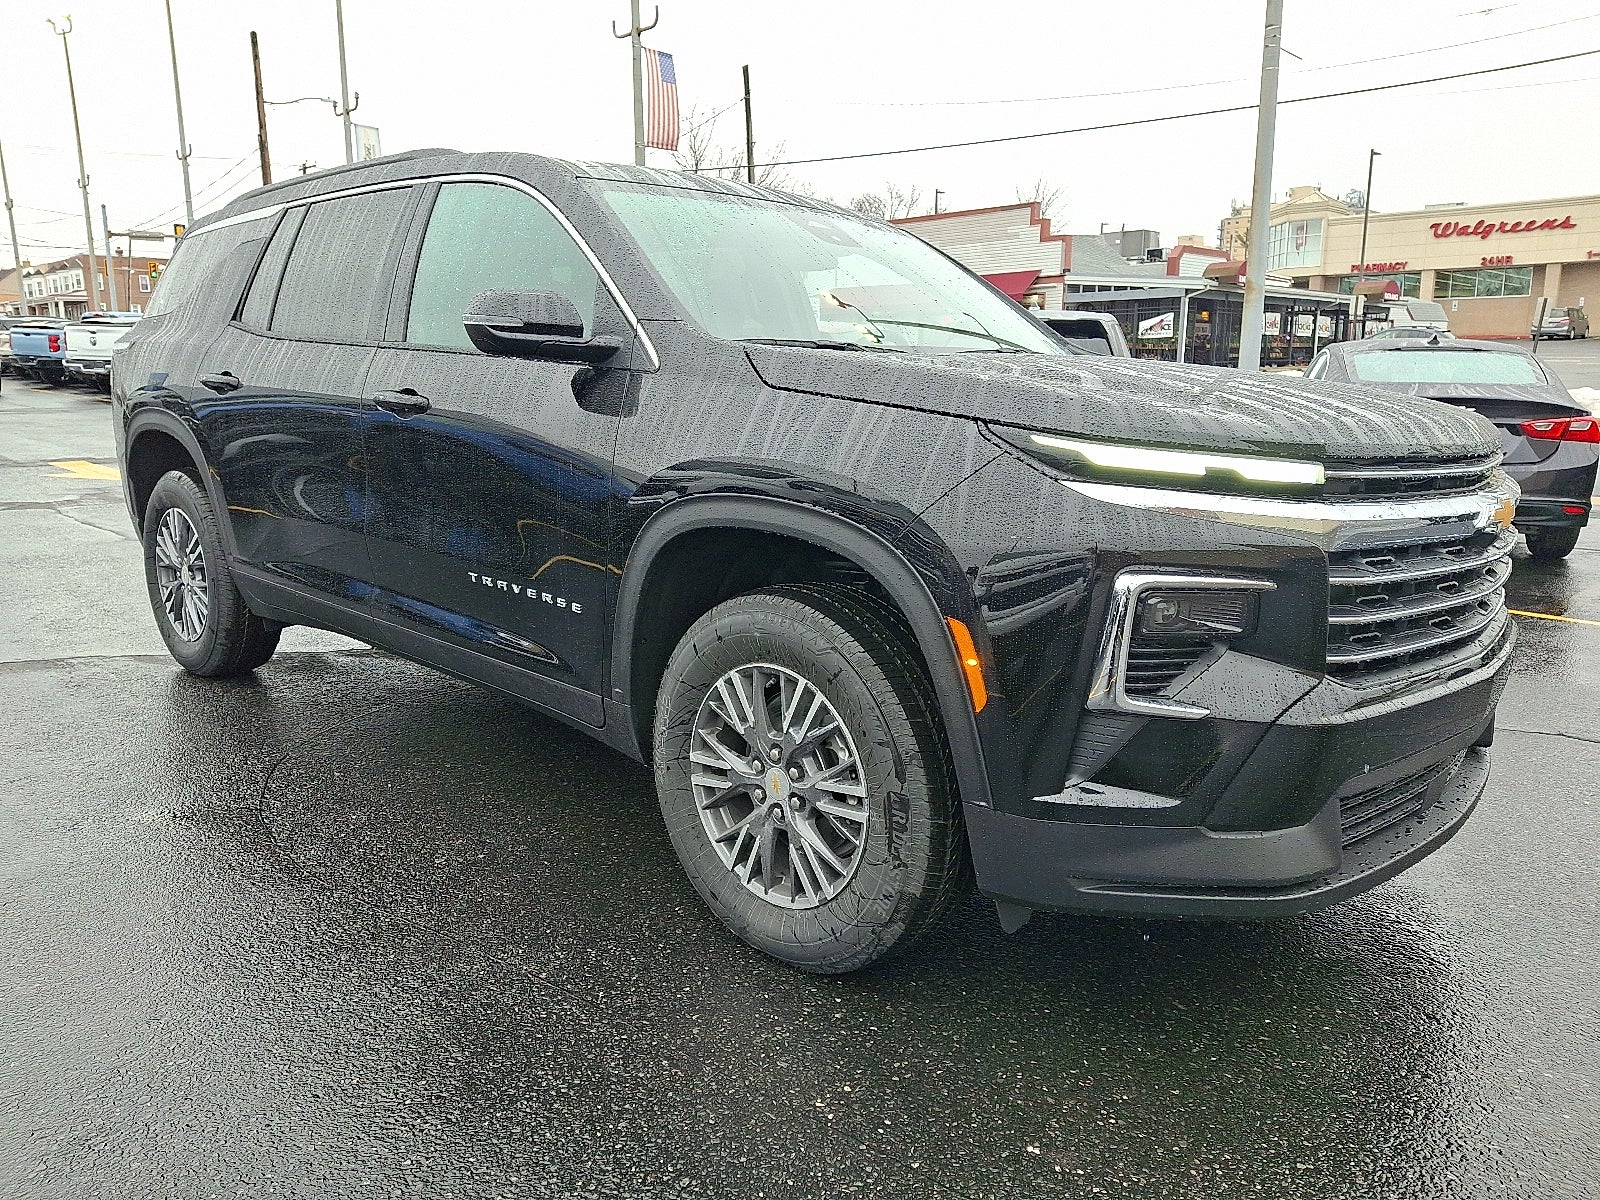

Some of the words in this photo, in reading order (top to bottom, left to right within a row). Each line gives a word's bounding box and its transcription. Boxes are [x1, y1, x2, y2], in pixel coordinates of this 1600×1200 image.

[1429, 215, 1577, 240] Walgreens
[1351, 261, 1408, 272] PHARMACY
[1481, 256, 1514, 266] 24HR
[467, 571, 583, 614] TRAVERSE
